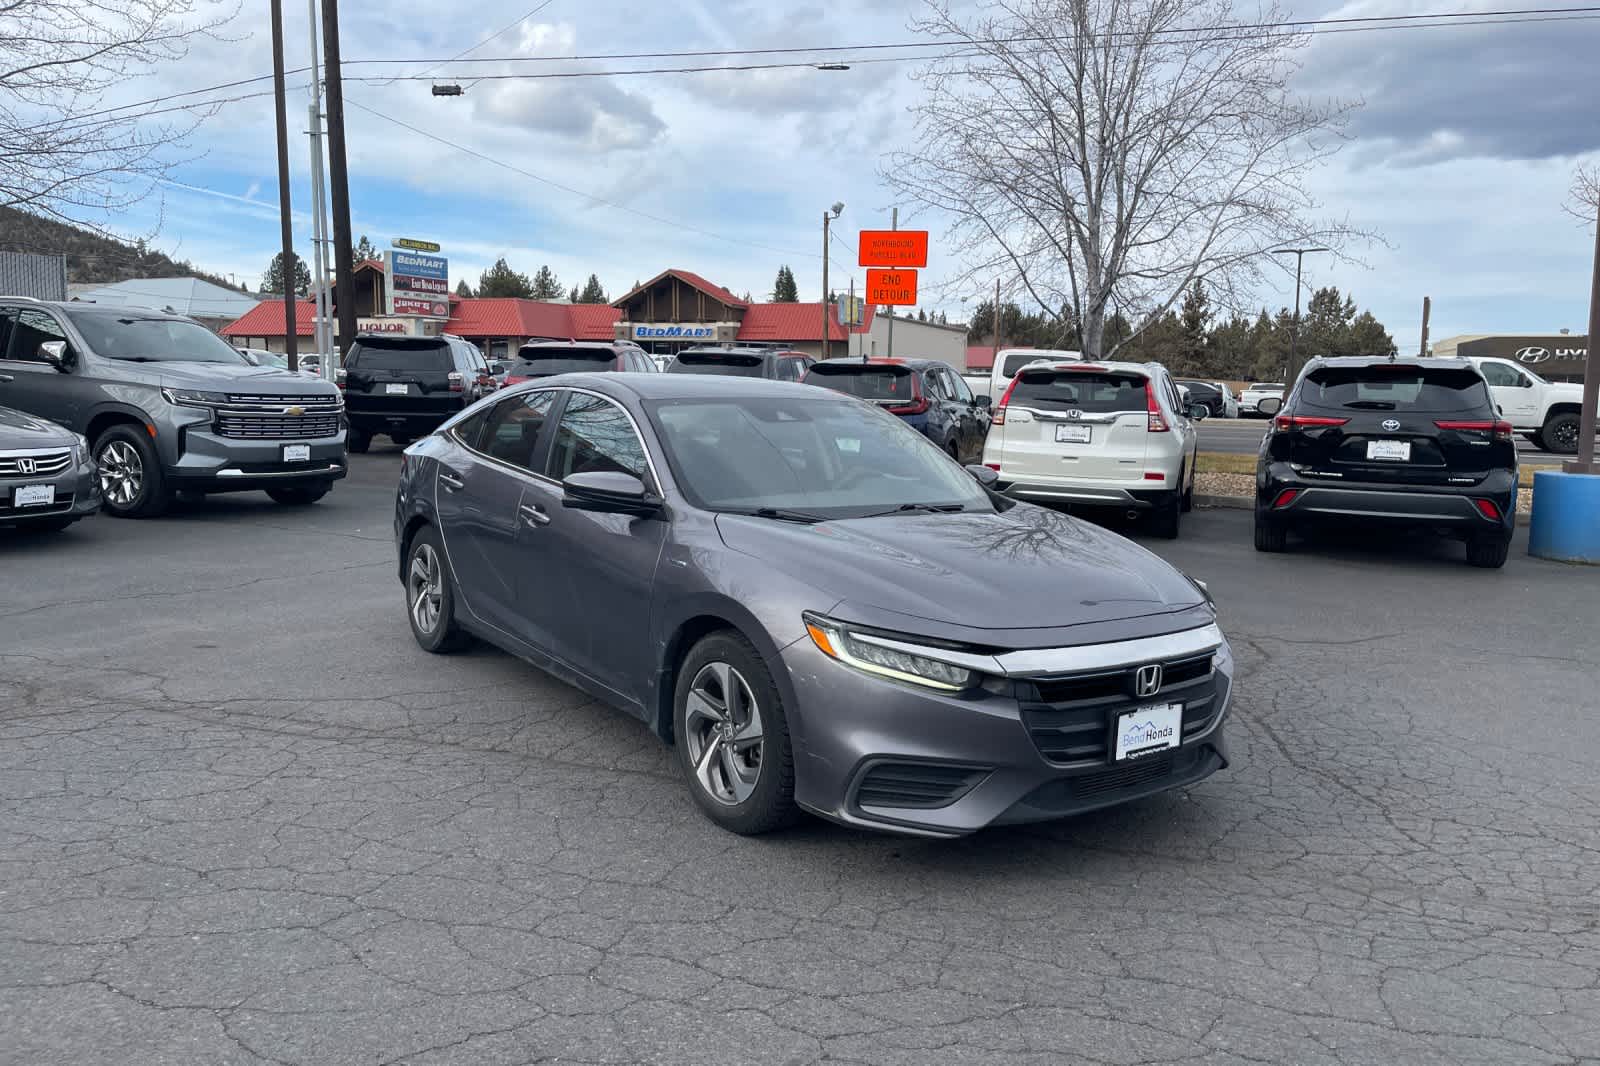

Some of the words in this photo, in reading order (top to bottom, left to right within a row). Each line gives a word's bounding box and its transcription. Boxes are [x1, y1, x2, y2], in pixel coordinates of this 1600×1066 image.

[882, 274, 901, 285] END
[873, 289, 910, 300] DETOUR
[360, 323, 405, 332] LIQUOR
